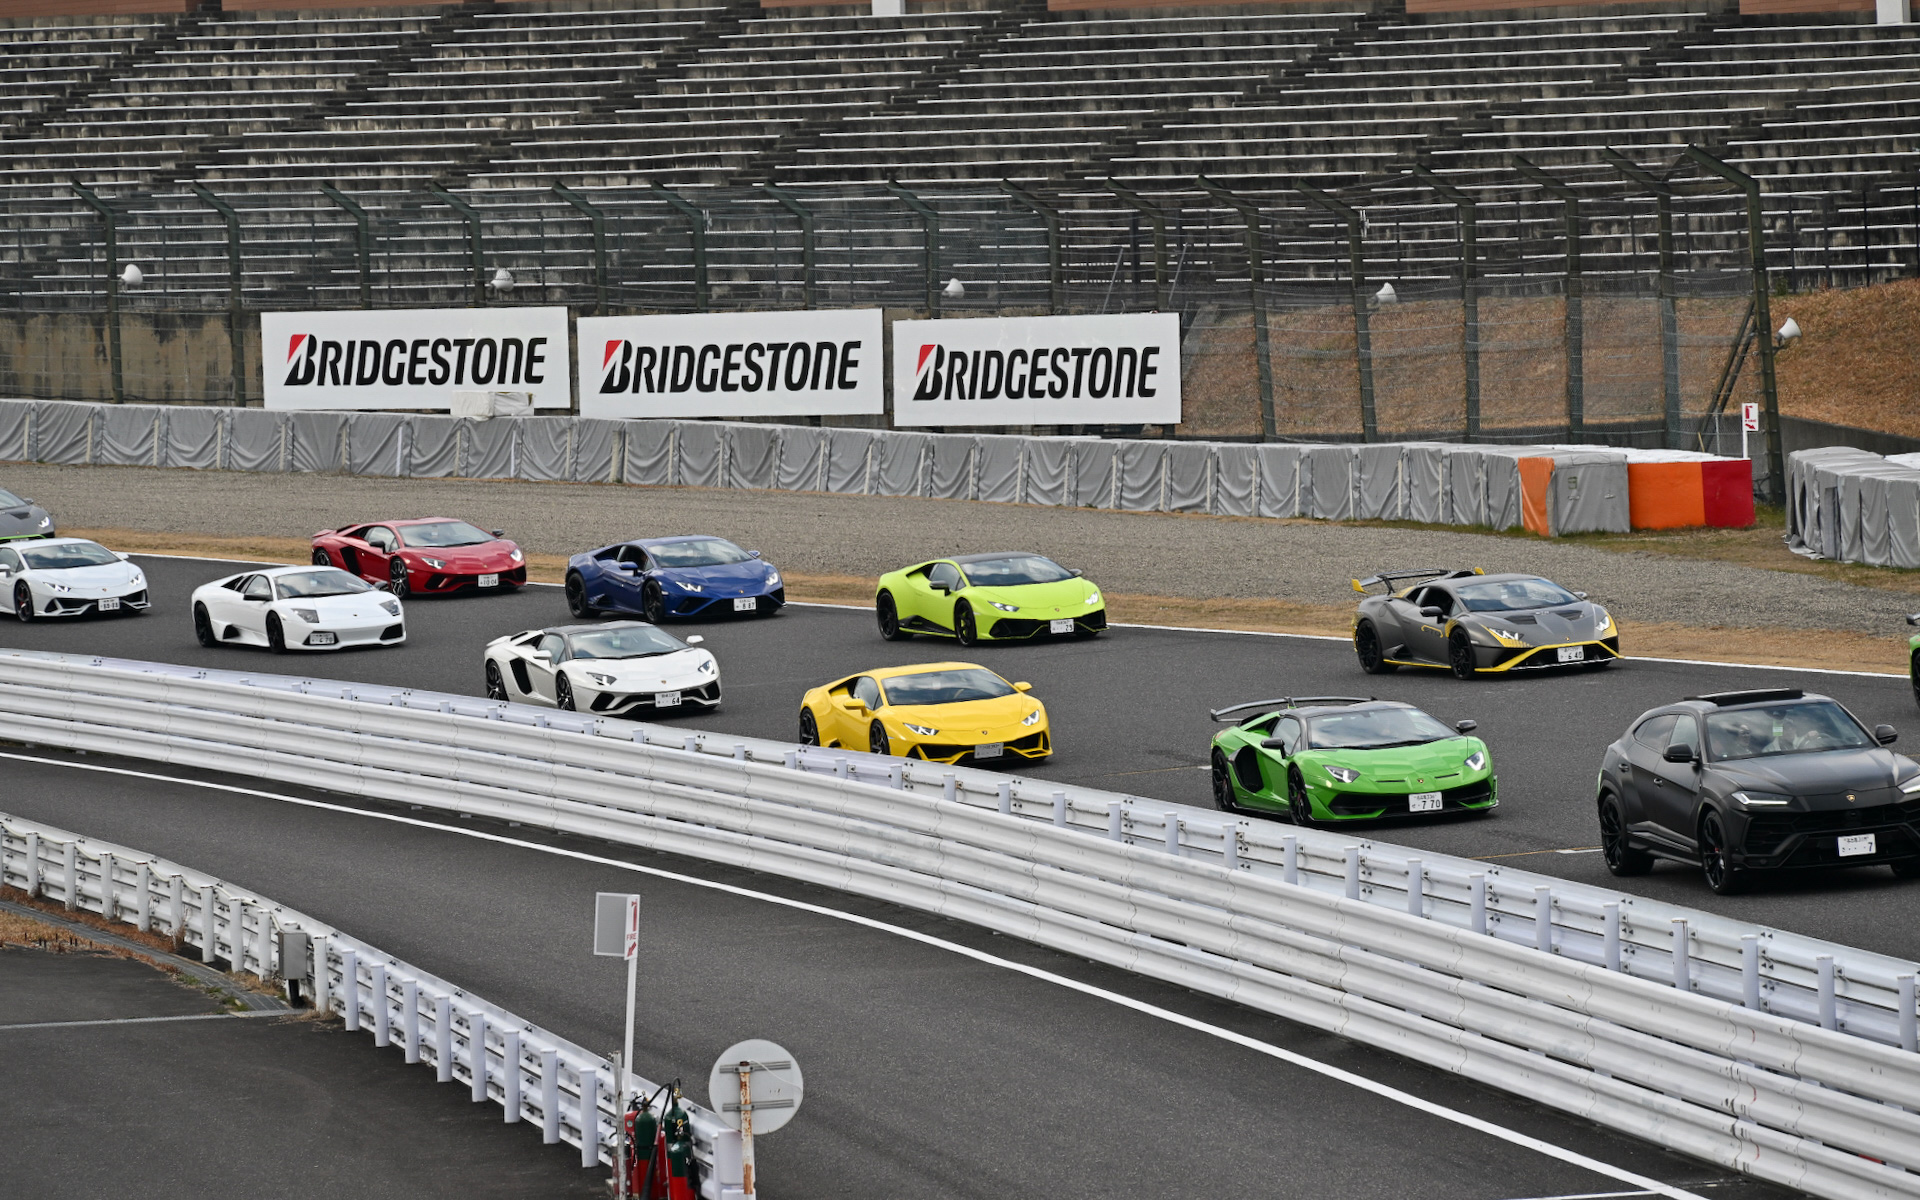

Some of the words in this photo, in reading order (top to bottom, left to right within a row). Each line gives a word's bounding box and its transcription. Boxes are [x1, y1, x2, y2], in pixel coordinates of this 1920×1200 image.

[284, 334, 547, 386] BRIDGESTONE
[599, 339, 861, 394] BRIDGESTONE
[913, 344, 1160, 401] BRIDGESTONE
